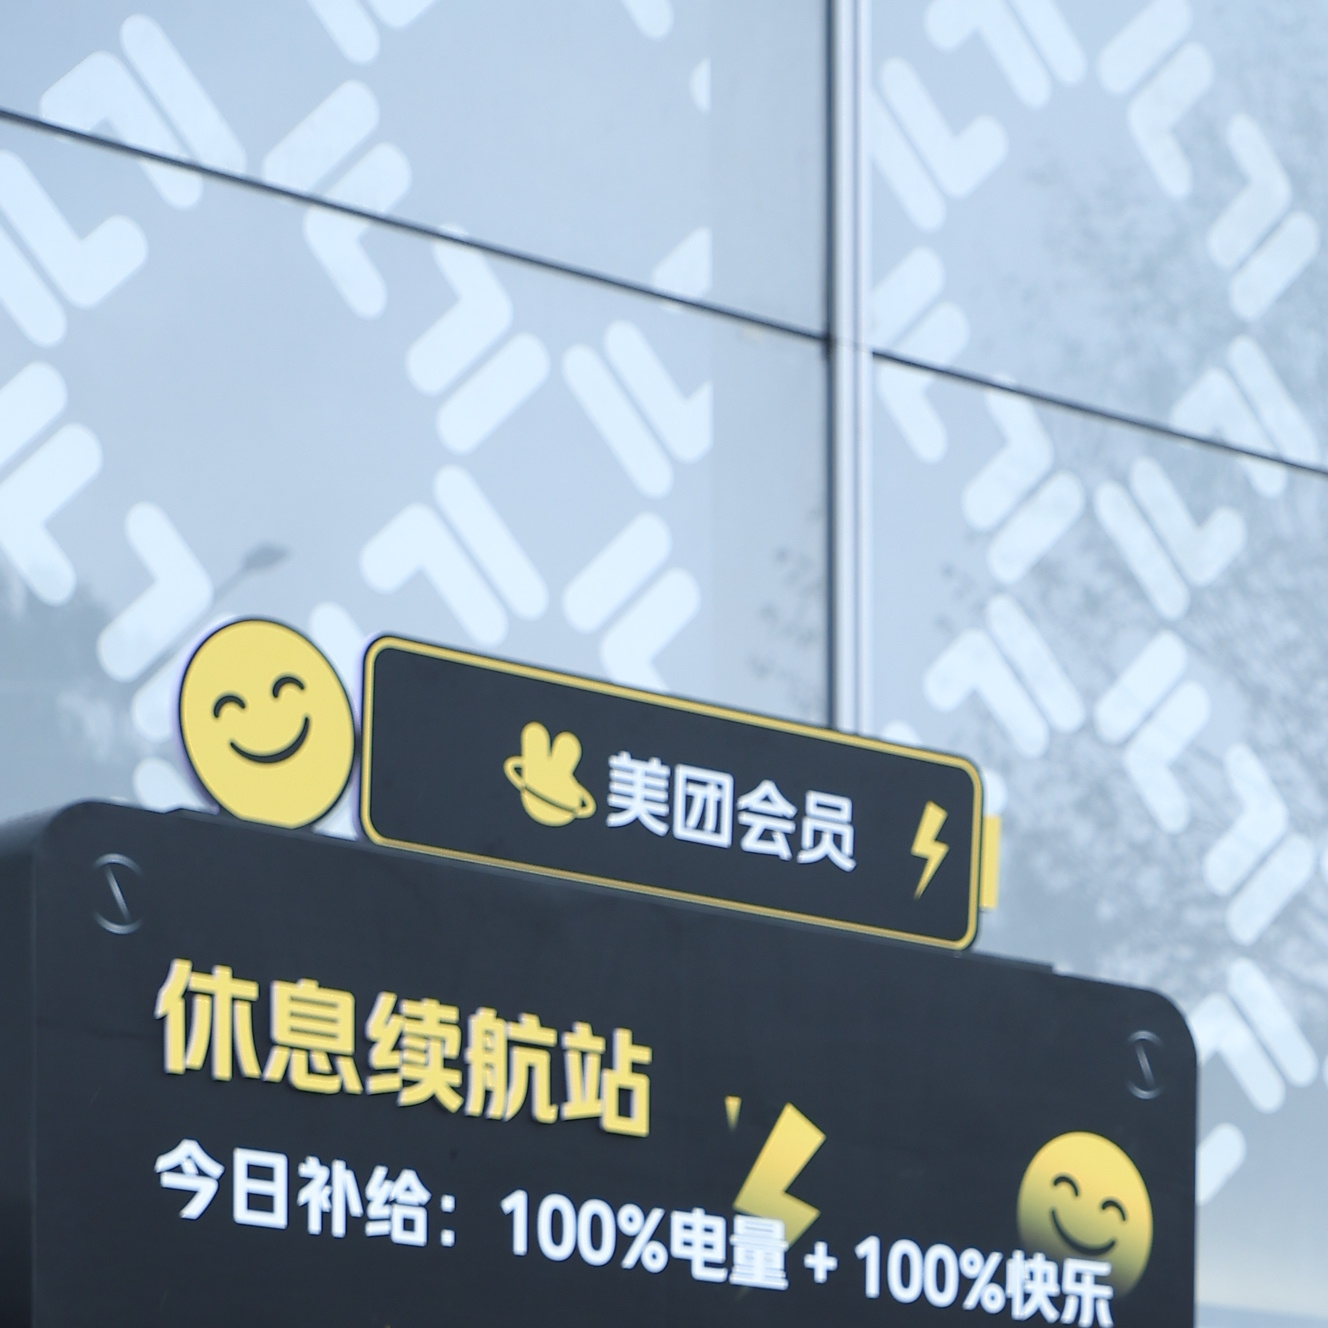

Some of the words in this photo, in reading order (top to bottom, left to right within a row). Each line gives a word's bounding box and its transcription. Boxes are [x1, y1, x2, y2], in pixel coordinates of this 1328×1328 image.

[606, 751, 857, 873] 美团会员
[155, 958, 653, 1138] 休息续航站
[500, 1189, 790, 1291] 100%电量
